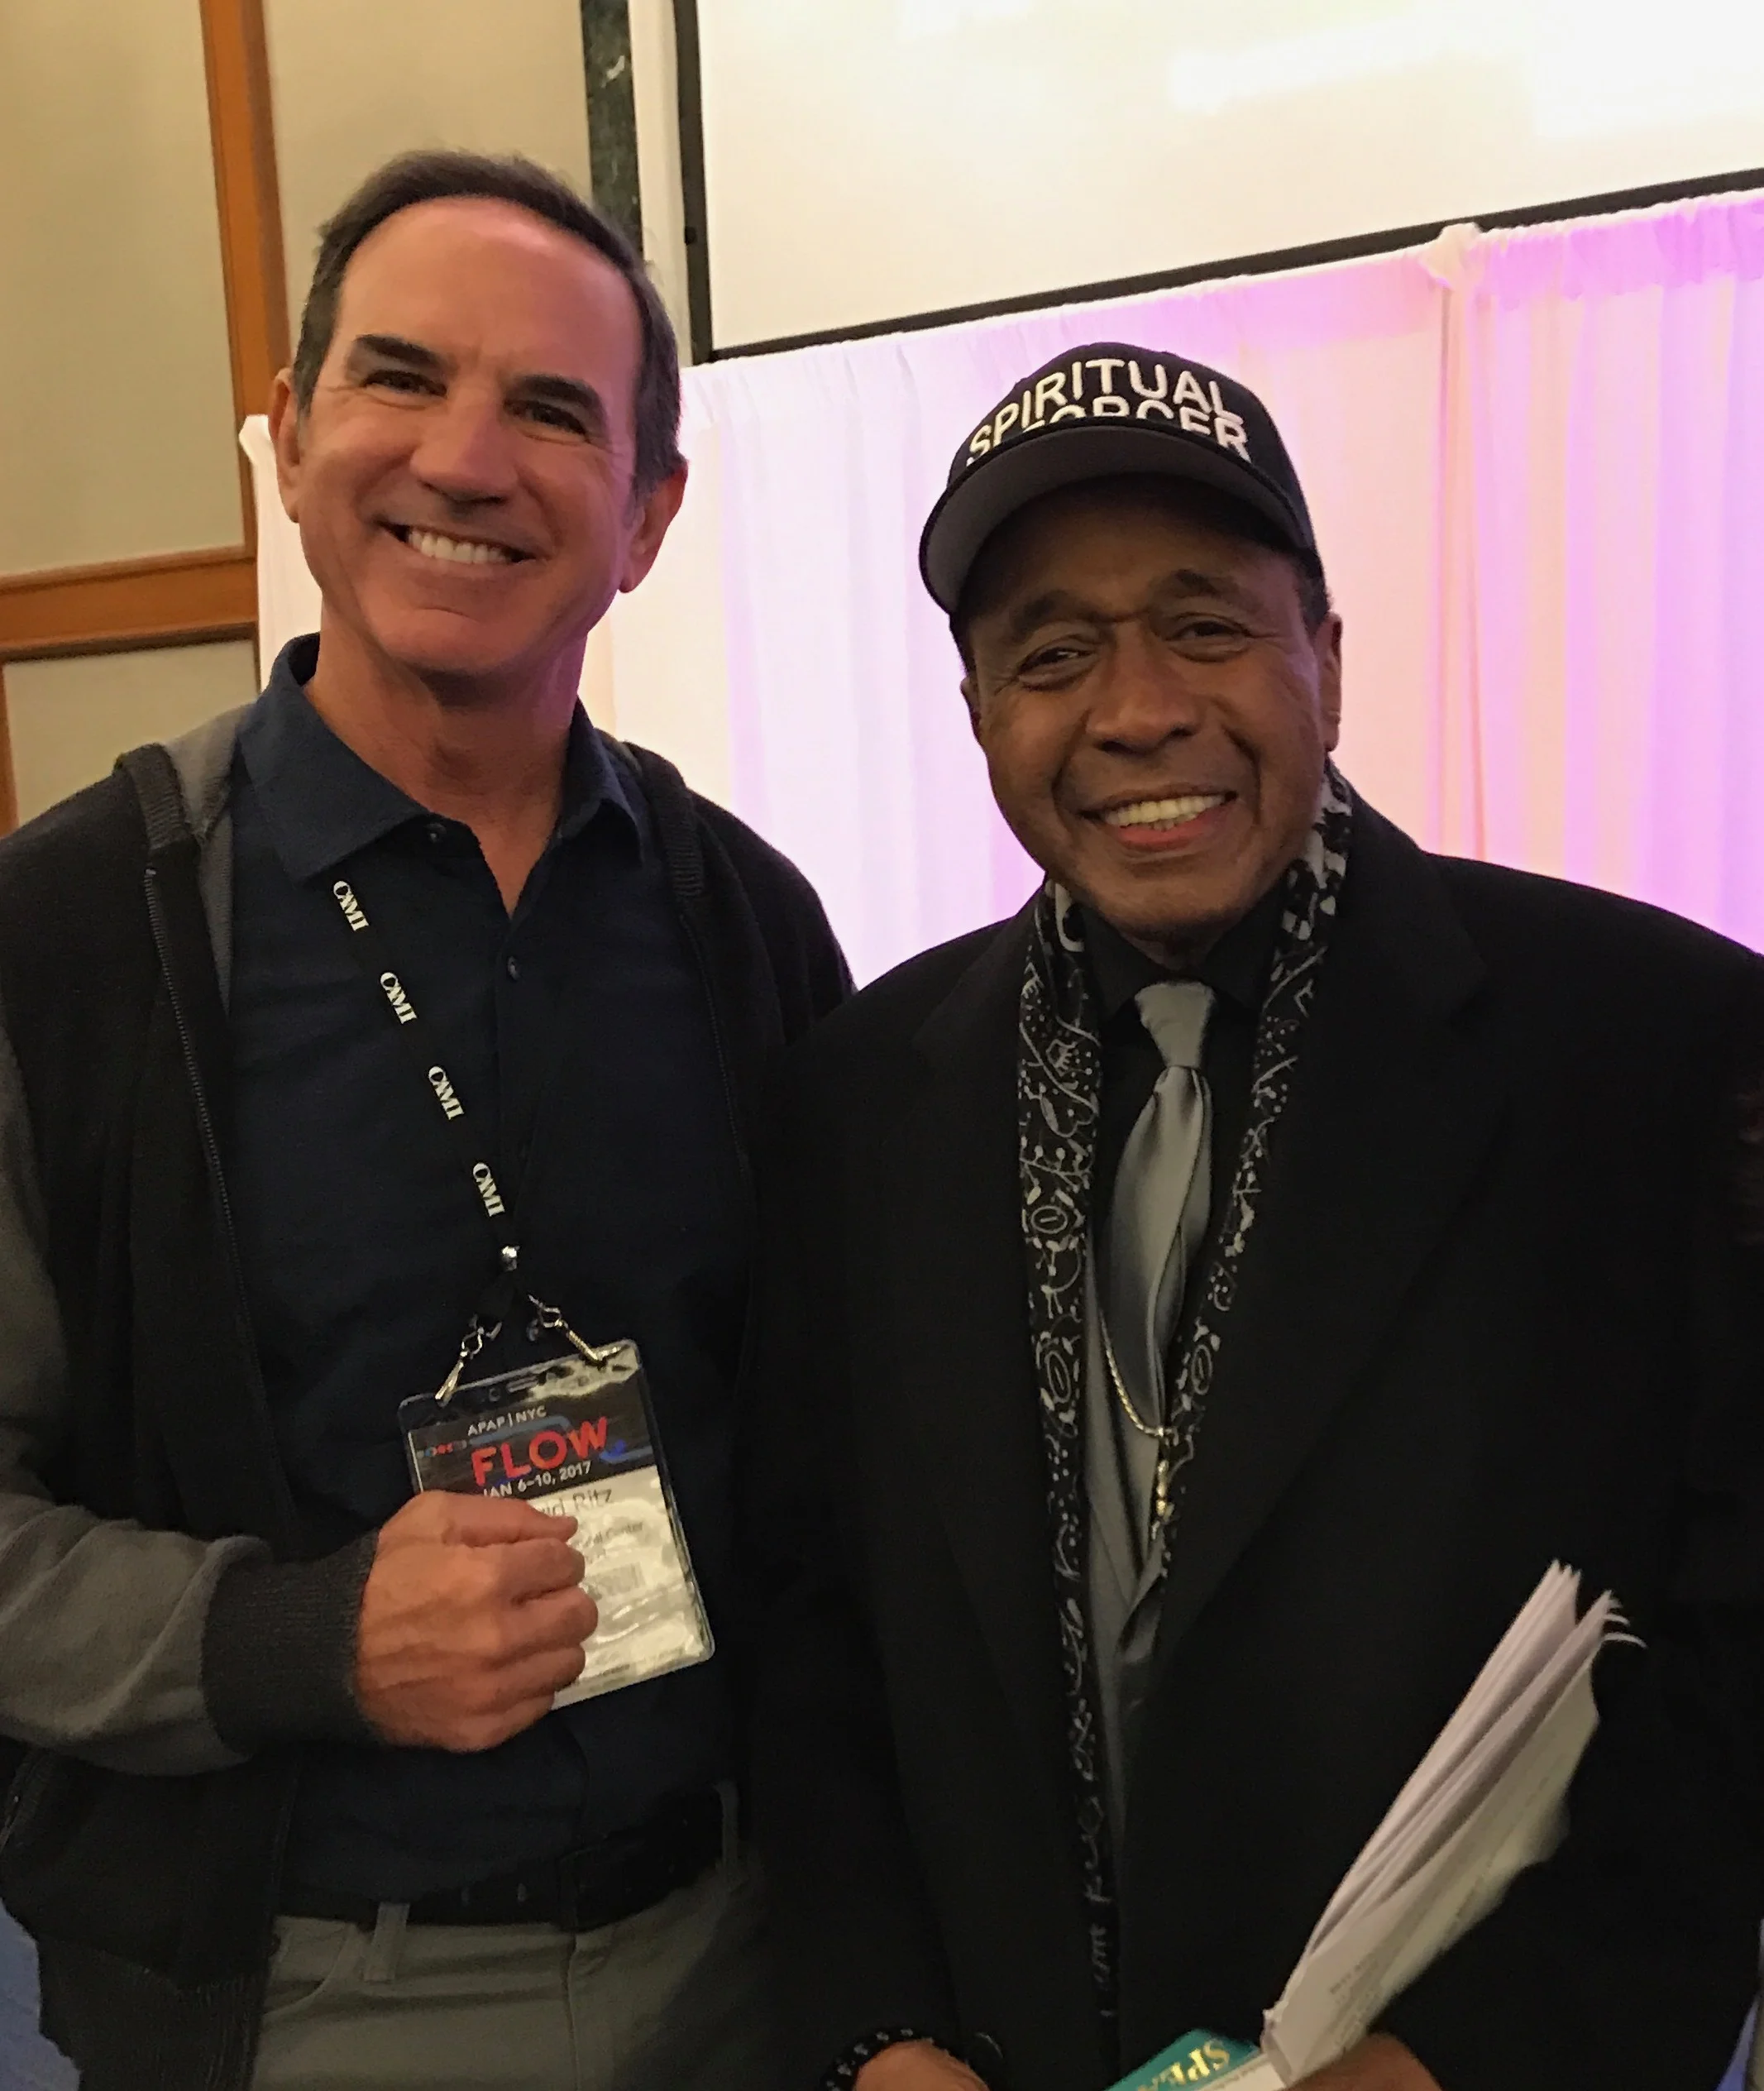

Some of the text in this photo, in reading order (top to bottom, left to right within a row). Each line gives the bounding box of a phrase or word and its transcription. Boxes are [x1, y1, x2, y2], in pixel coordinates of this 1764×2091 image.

[968, 357, 1244, 457] SPIRITUAL
[471, 1416, 608, 1486] FLOW
[559, 1461, 592, 1481] 2017
